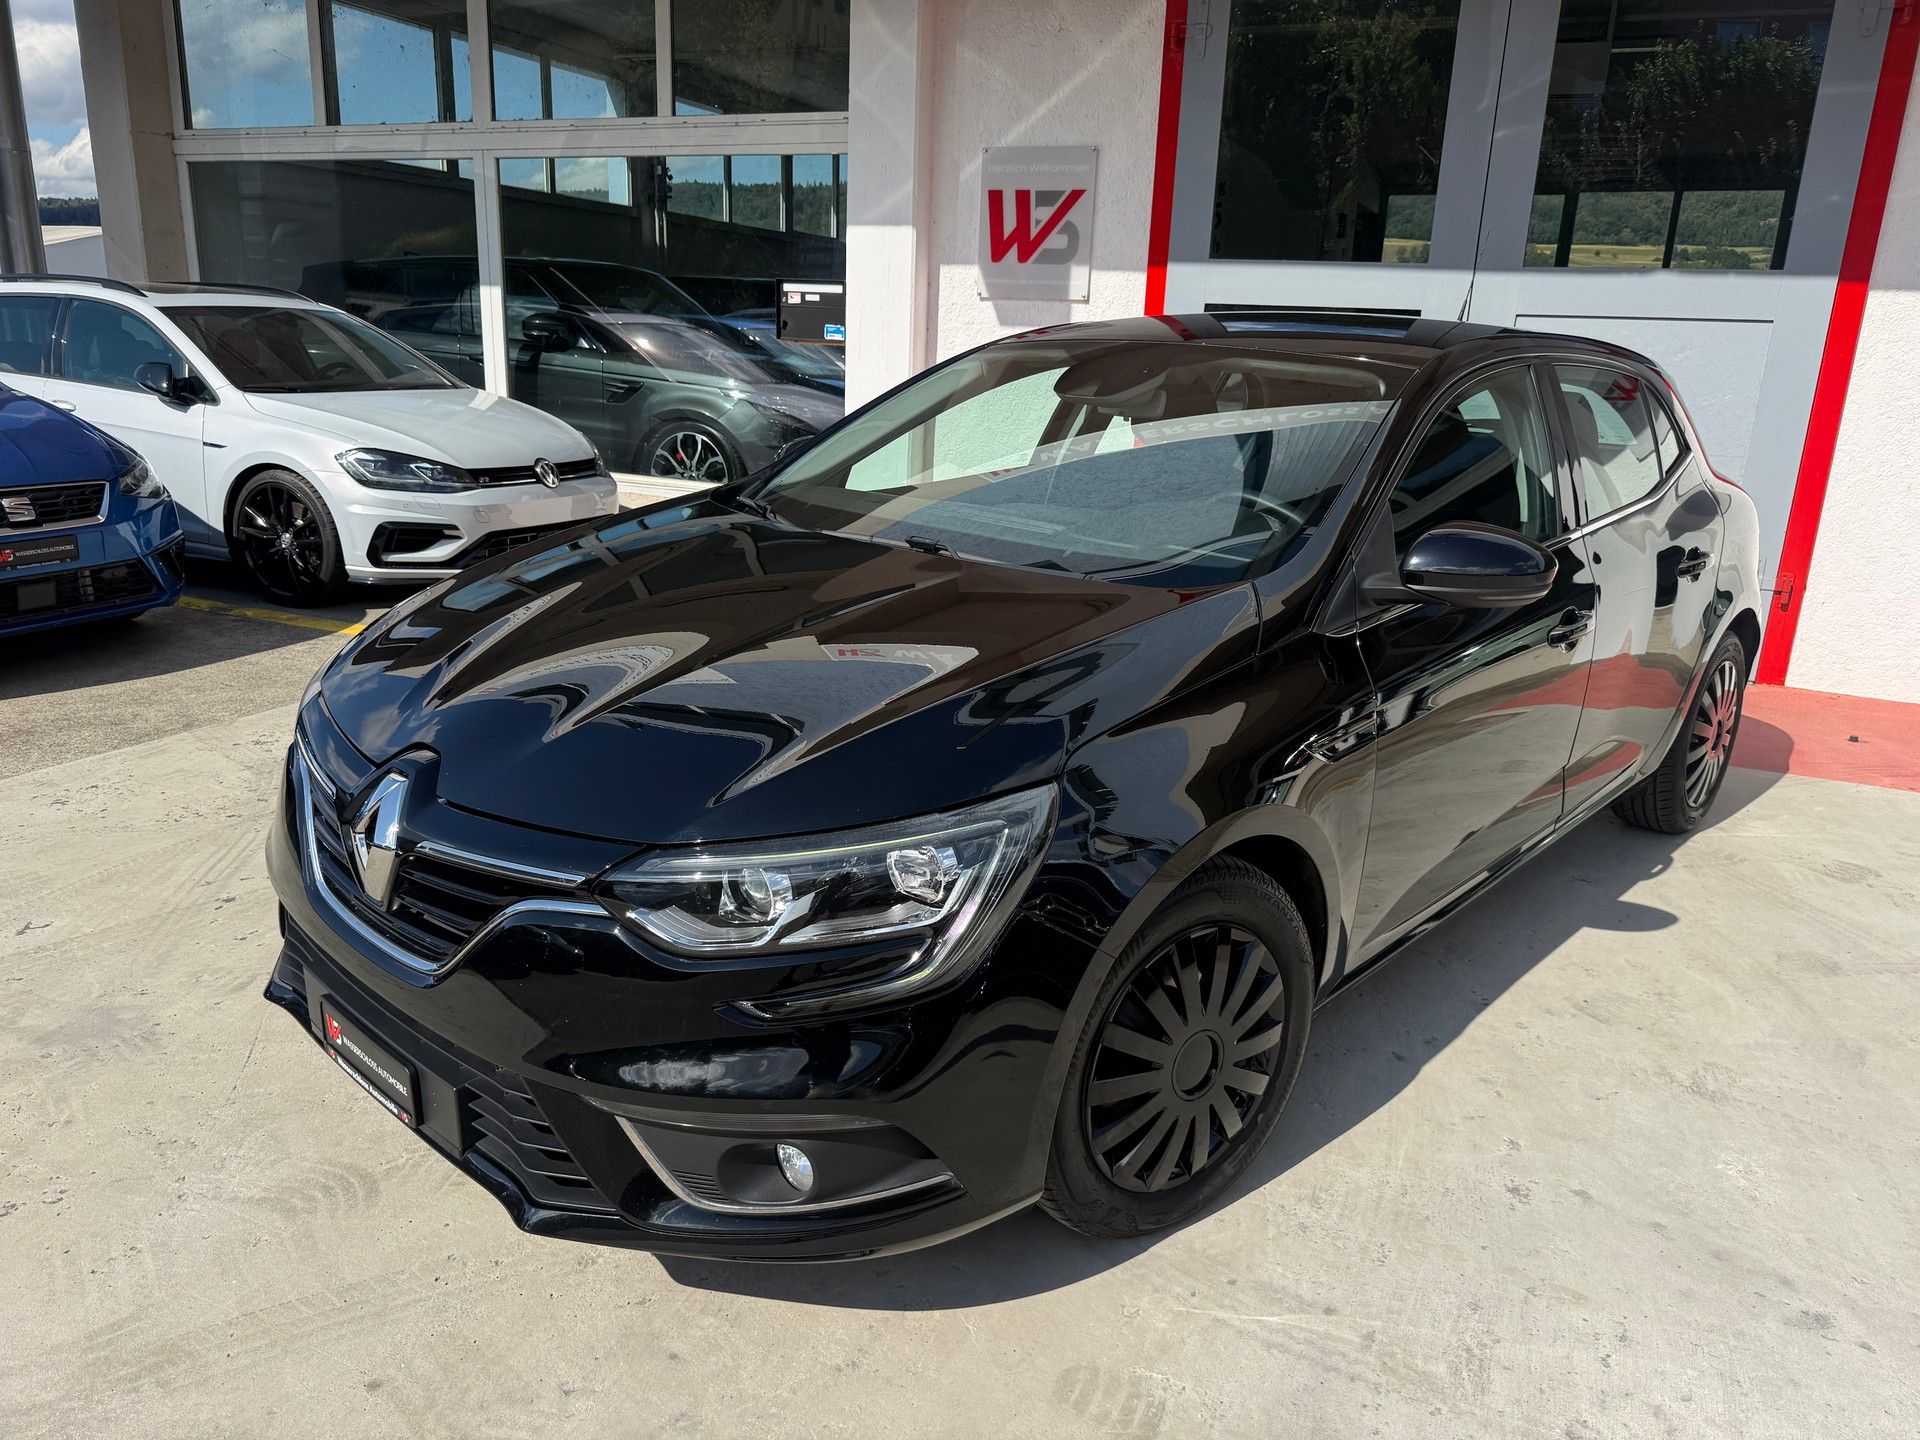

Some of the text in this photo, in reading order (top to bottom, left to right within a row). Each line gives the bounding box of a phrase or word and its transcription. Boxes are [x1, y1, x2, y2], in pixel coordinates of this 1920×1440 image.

[988, 163, 1089, 173] Herzlich Willkommen
[49, 544, 74, 552] AUTOMOBILE
[377, 1066, 408, 1097] AUTOMOBILE
